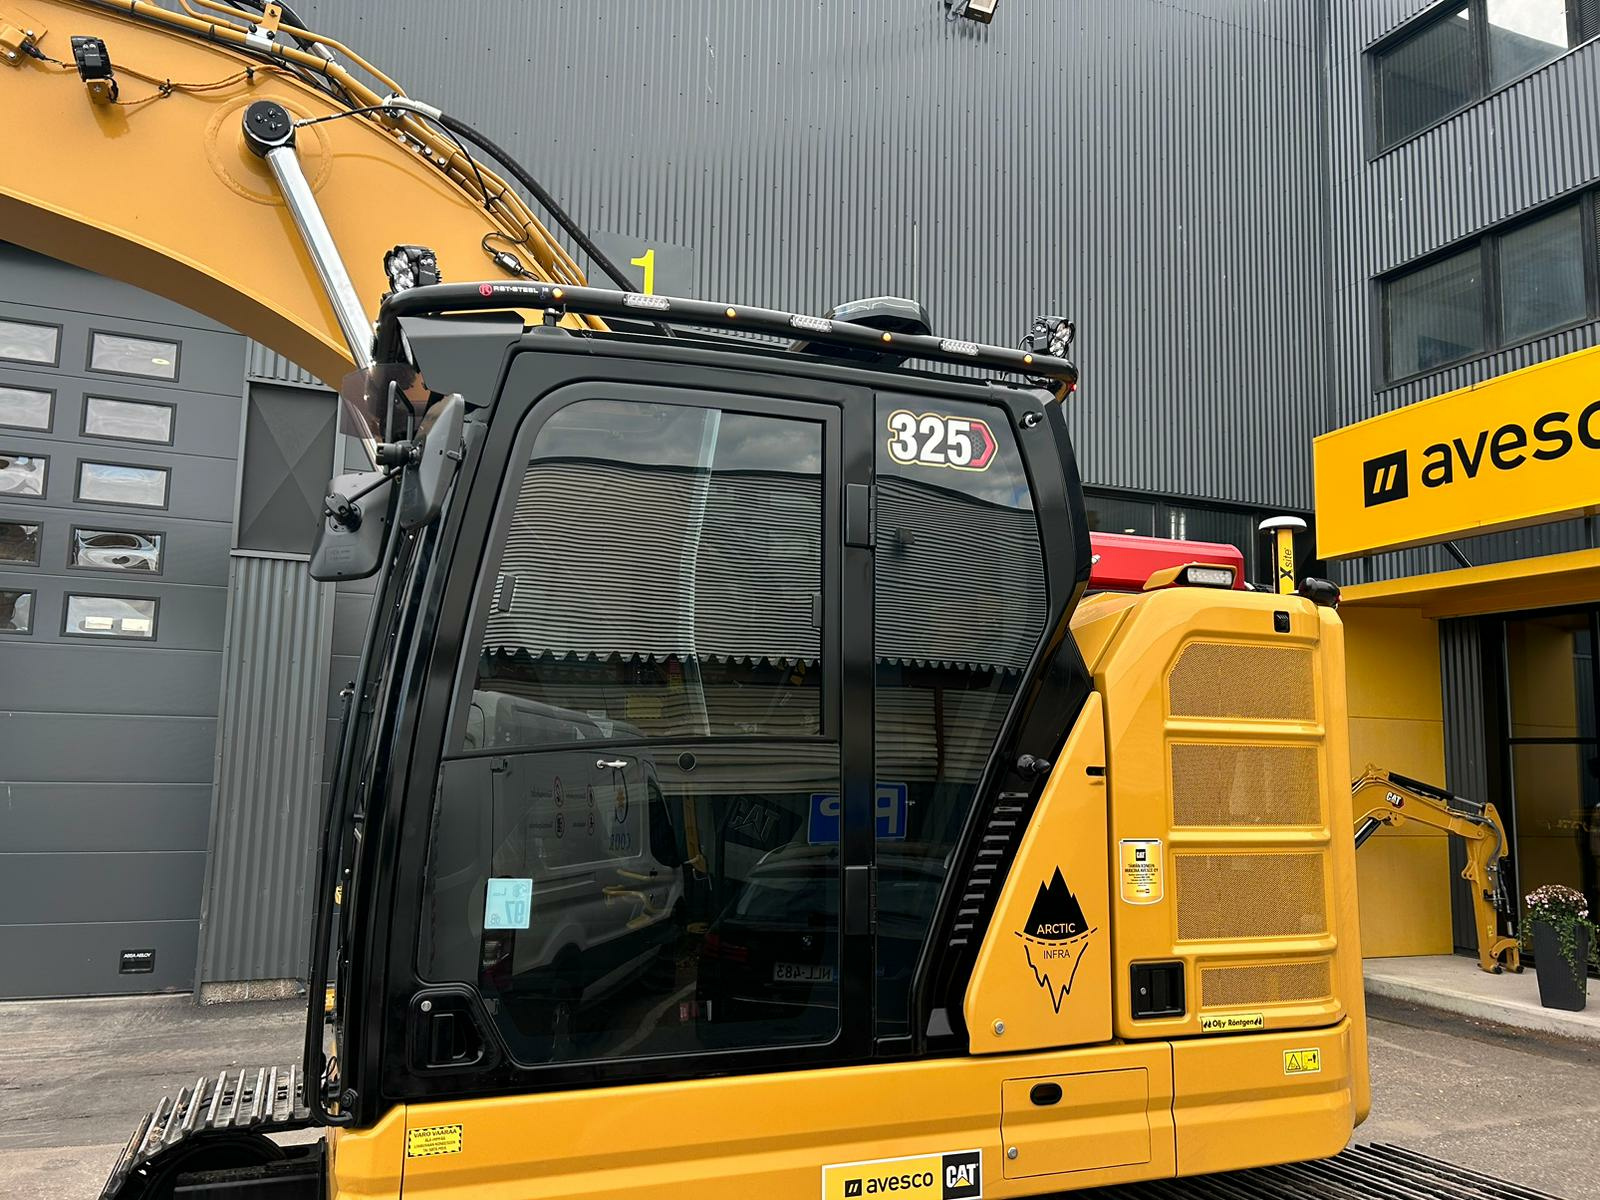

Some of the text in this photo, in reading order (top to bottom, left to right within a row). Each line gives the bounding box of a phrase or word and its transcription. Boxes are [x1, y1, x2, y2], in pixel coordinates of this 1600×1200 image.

[630, 248, 655, 296] 1
[891, 413, 972, 466] 325
[1386, 792, 1402, 805] CAT
[1036, 923, 1076, 934] ARCTIC
[1043, 949, 1071, 960] INFRA
[866, 1163, 977, 1194] avesco CAT
